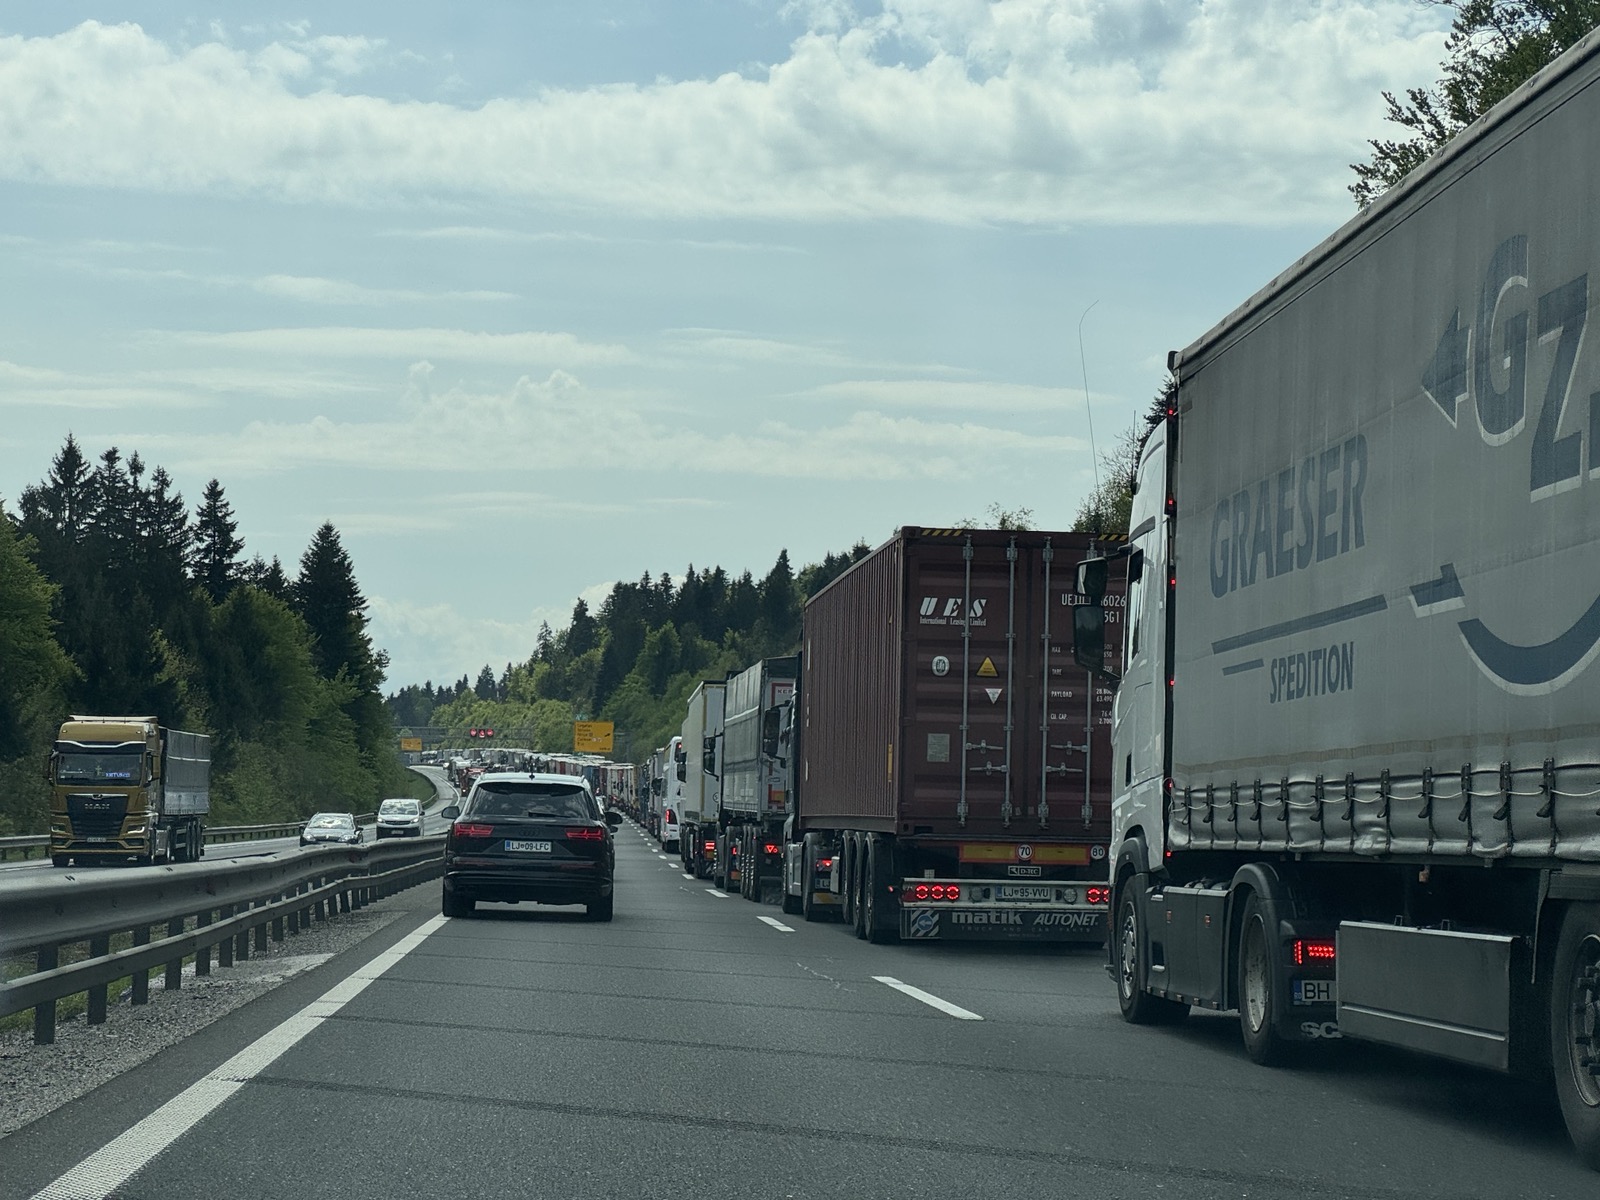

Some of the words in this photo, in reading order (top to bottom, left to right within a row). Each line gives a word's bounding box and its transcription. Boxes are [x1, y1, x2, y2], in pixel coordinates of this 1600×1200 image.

[1209, 433, 1368, 598] GRAESER
[919, 597, 987, 617] UES
[919, 616, 947, 625] International
[970, 618, 987, 626] Limited
[1270, 641, 1354, 703] SPEDITION
[1050, 690, 1073, 698] PAYLOAD
[1020, 846, 1031, 856] 70
[1092, 847, 1104, 857] 80
[951, 910, 1023, 925] matik
[1033, 911, 1100, 928] AUTONET
[1304, 982, 1330, 1000] BH
[1300, 1021, 1343, 1039] SC
